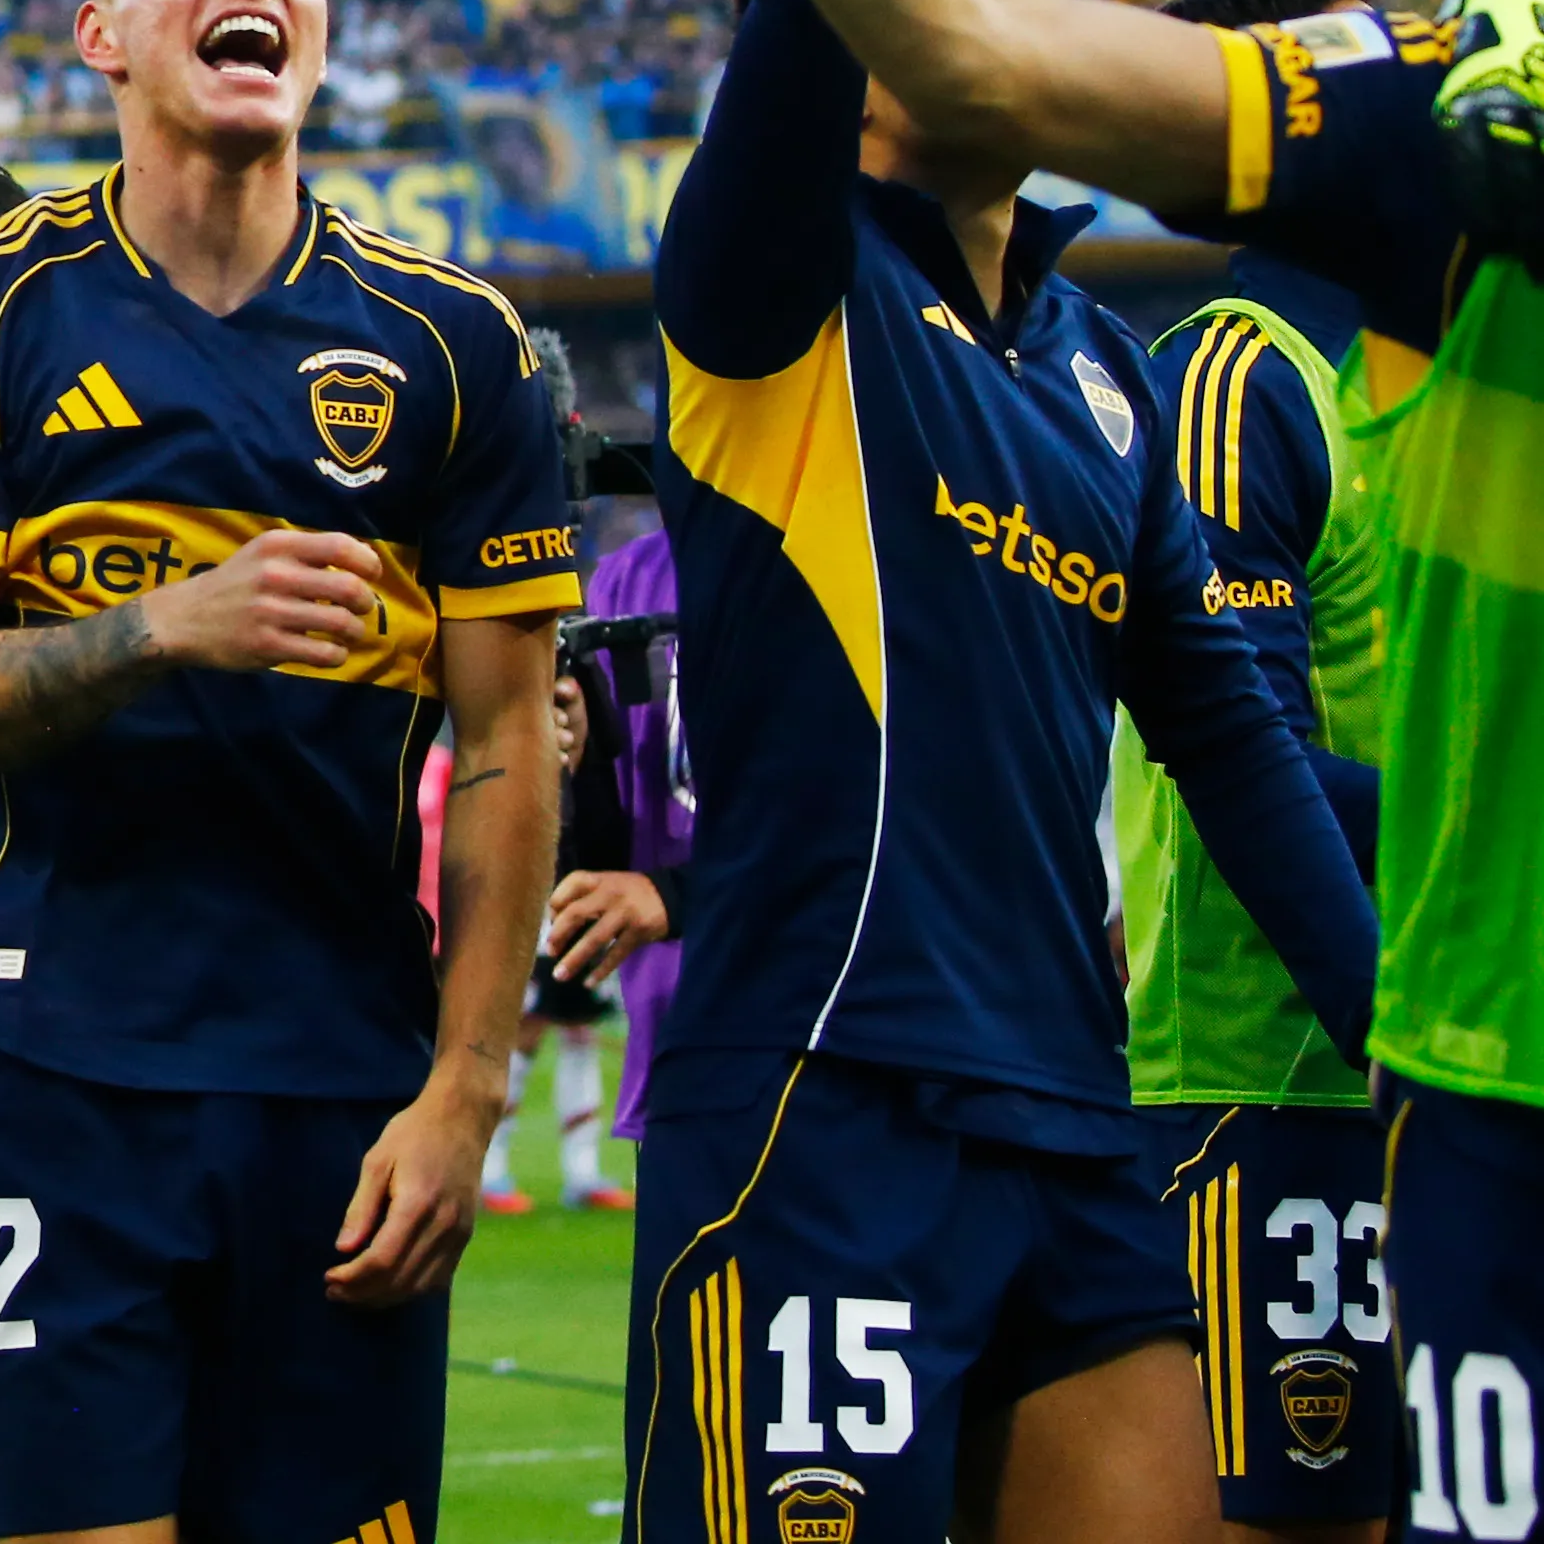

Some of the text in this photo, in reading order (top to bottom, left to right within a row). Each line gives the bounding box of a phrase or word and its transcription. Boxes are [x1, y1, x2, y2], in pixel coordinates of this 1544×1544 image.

[324, 404, 380, 425] CABJ
[1265, 1197, 1392, 1344] 33
[765, 1295, 914, 1454] 15
[1292, 1398, 1340, 1414] CABJ
[1405, 1342, 1539, 1541] 10
[790, 1522, 842, 1539] CABJ
